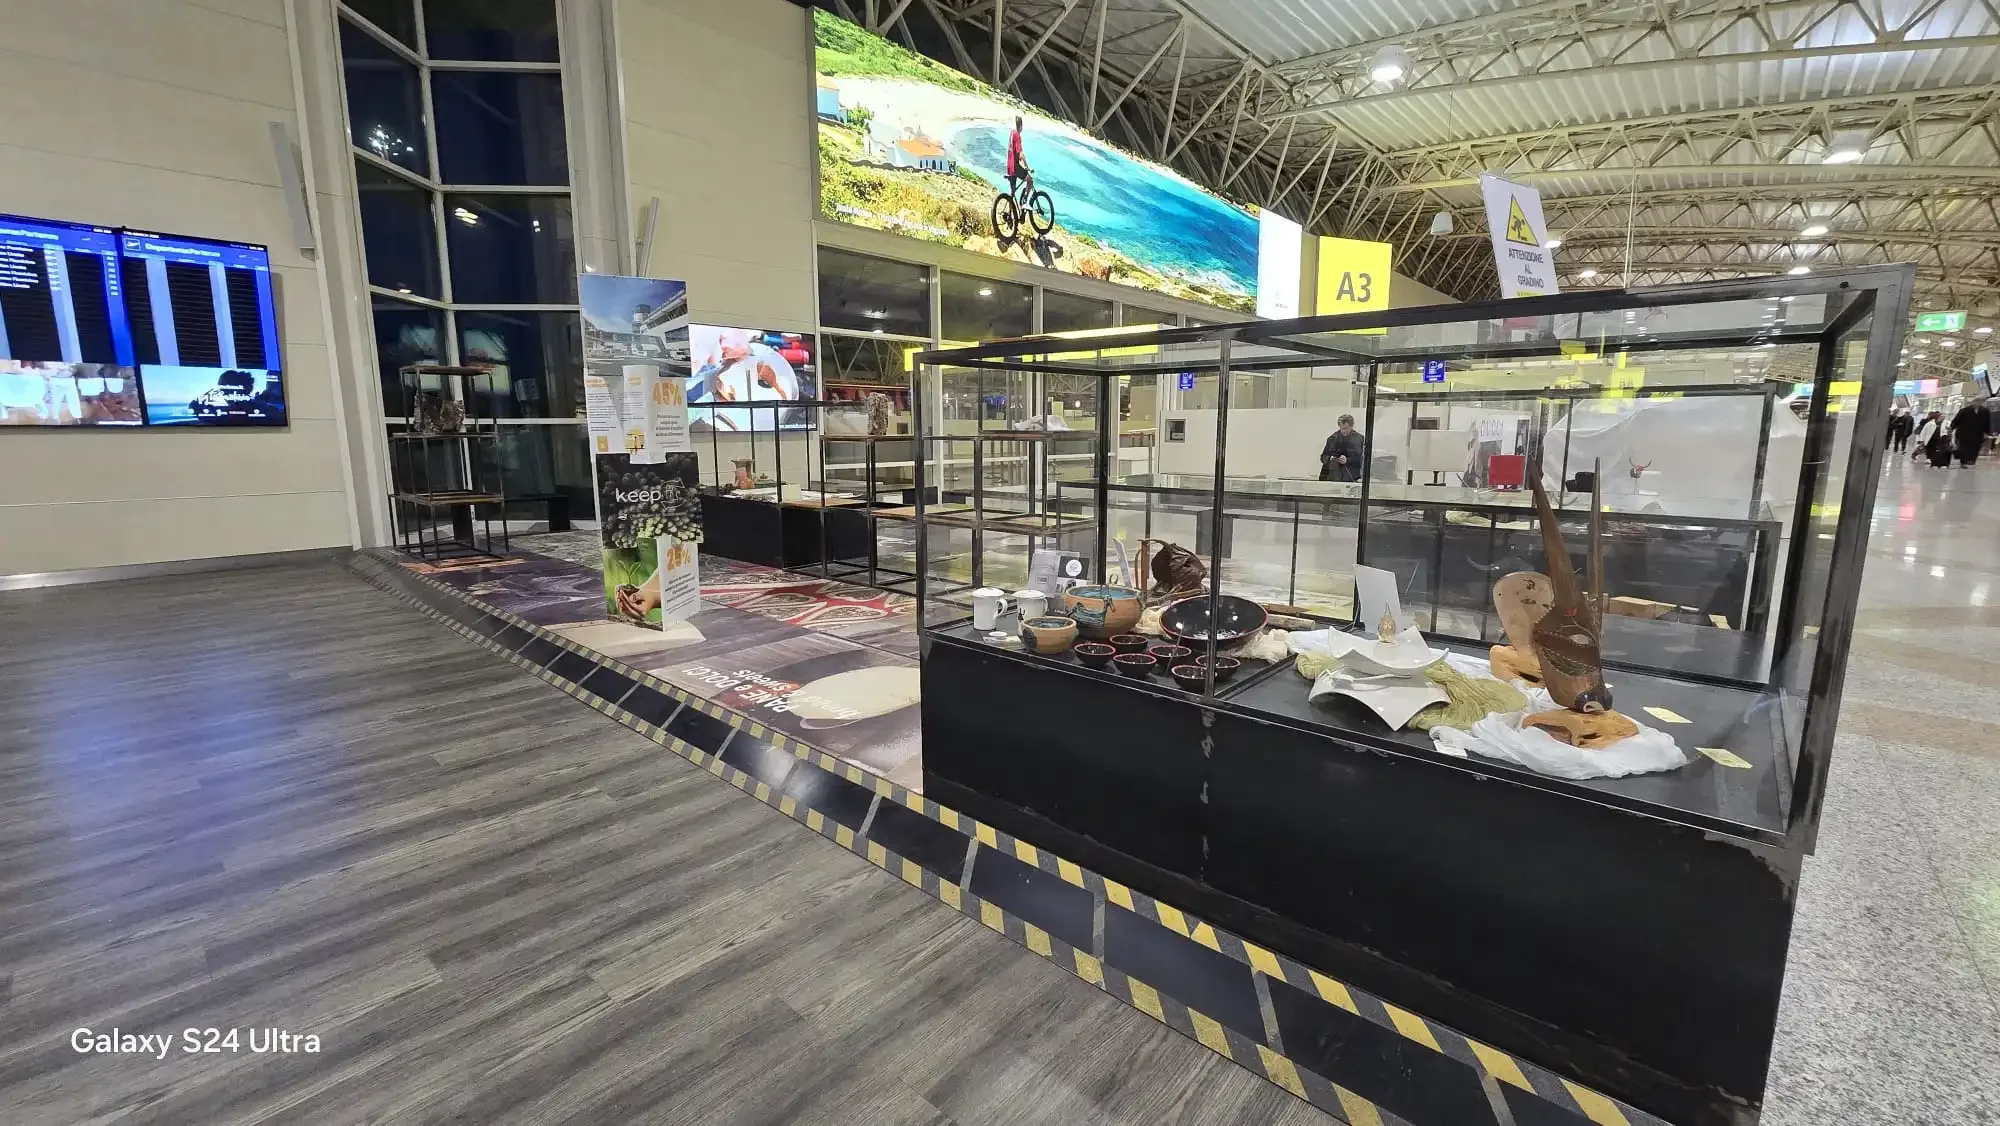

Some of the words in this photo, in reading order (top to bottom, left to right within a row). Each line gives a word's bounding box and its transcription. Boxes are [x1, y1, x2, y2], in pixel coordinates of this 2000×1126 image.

[1508, 248, 1544, 264] ATTENZIONE
[1524, 264, 1533, 275] AL
[1336, 271, 1372, 303] A3
[1517, 275, 1545, 289] GRADINO
[653, 381, 683, 408] 45%
[615, 487, 662, 505] keep
[666, 545, 691, 572] 25%
[680, 666, 742, 690] DOLCI
[739, 689, 800, 713] PANE
